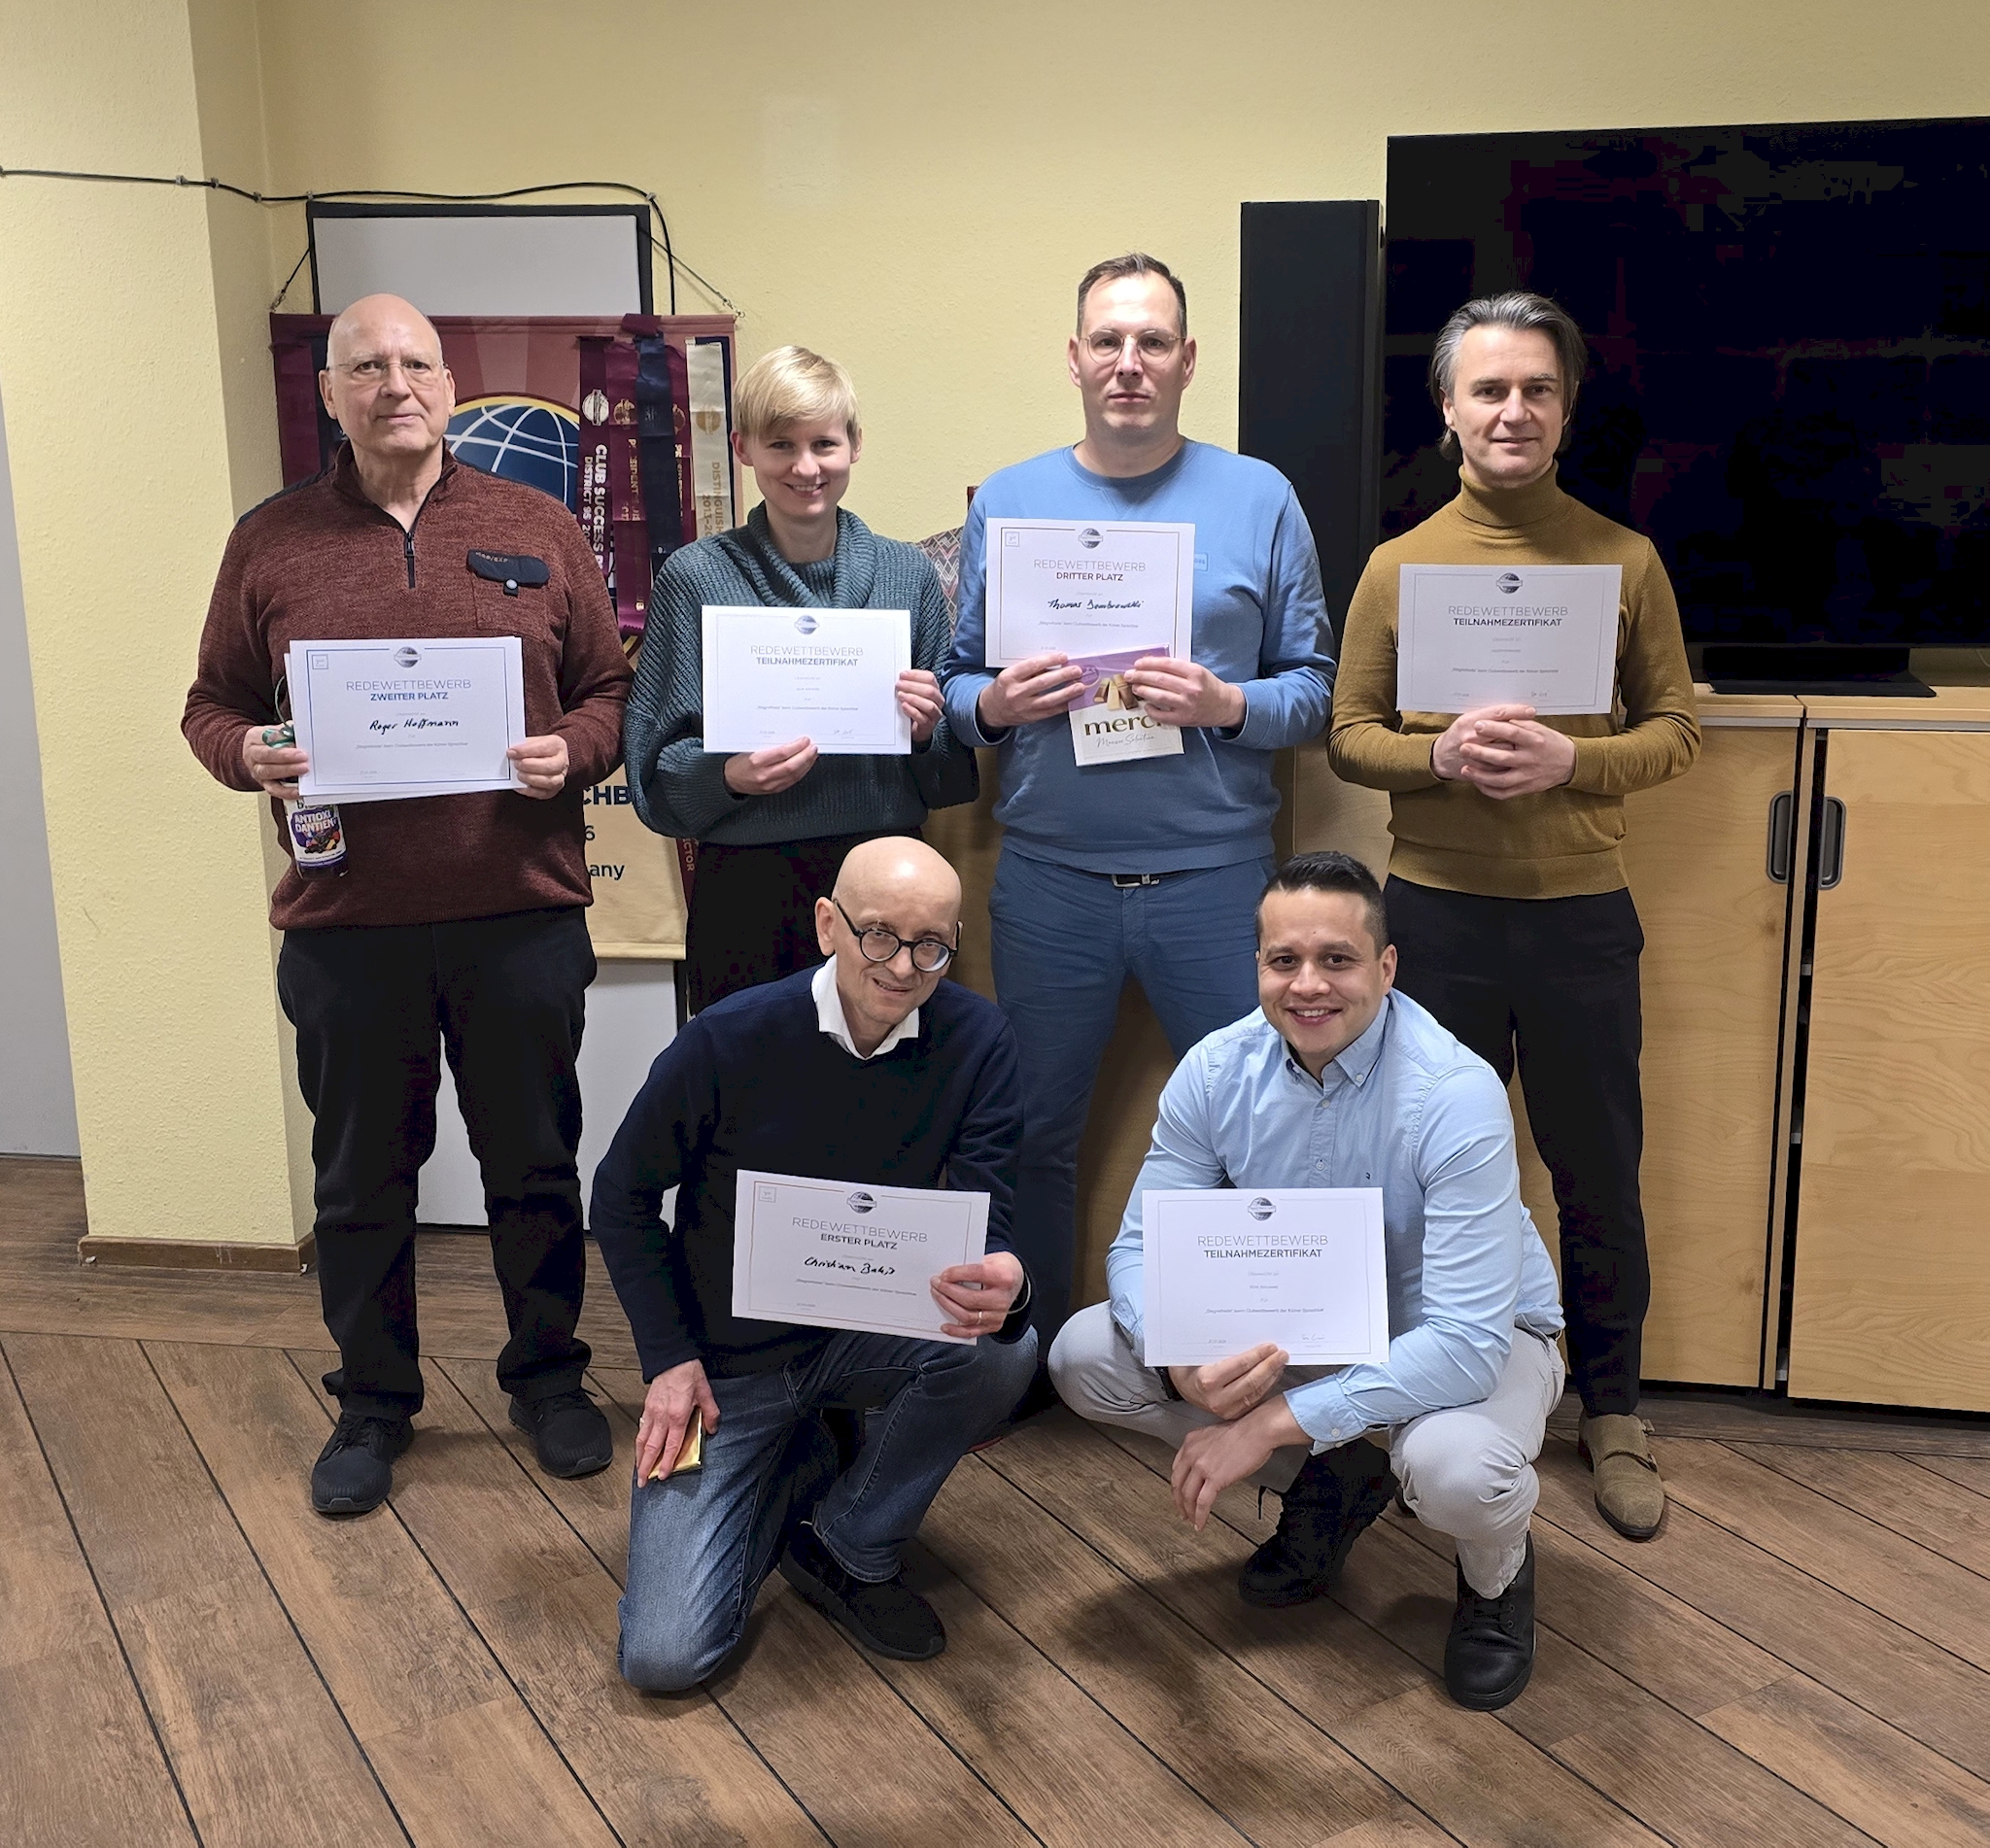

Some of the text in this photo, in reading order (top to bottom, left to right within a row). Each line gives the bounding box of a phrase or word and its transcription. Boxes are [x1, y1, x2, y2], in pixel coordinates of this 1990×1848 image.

[595, 444, 607, 484] CLUB
[583, 456, 593, 504] DISTRICT
[583, 506, 592, 520] 95
[593, 486, 605, 552] SUCCESS
[1034, 559, 1147, 571] REDEWETTBEWERB
[1056, 571, 1123, 582] DRITTER PLATZ
[1047, 599, 1082, 609] Thomas
[1448, 605, 1568, 616] REDEWETTBEWERB
[1453, 618, 1562, 627] TEILNAHMEZERTIFIKAT
[750, 645, 864, 656] REDEWETTBEWERB
[756, 657, 859, 667] TEILNAHMEZERTIFIKAT
[346, 679, 471, 691] REDEWETTBEWERB
[370, 691, 449, 701] ZWEITER PLATZ
[369, 718, 459, 735] Roger Hoffmann
[792, 1216, 928, 1243] REDEWETTBEWERB
[820, 1233, 898, 1249] ERSTER PLATZ
[1197, 1234, 1328, 1246] REDEWETTBEWERB
[1204, 1249, 1322, 1258] TEILNAHMEZERTIFIKAT
[805, 1256, 856, 1272] Christian
